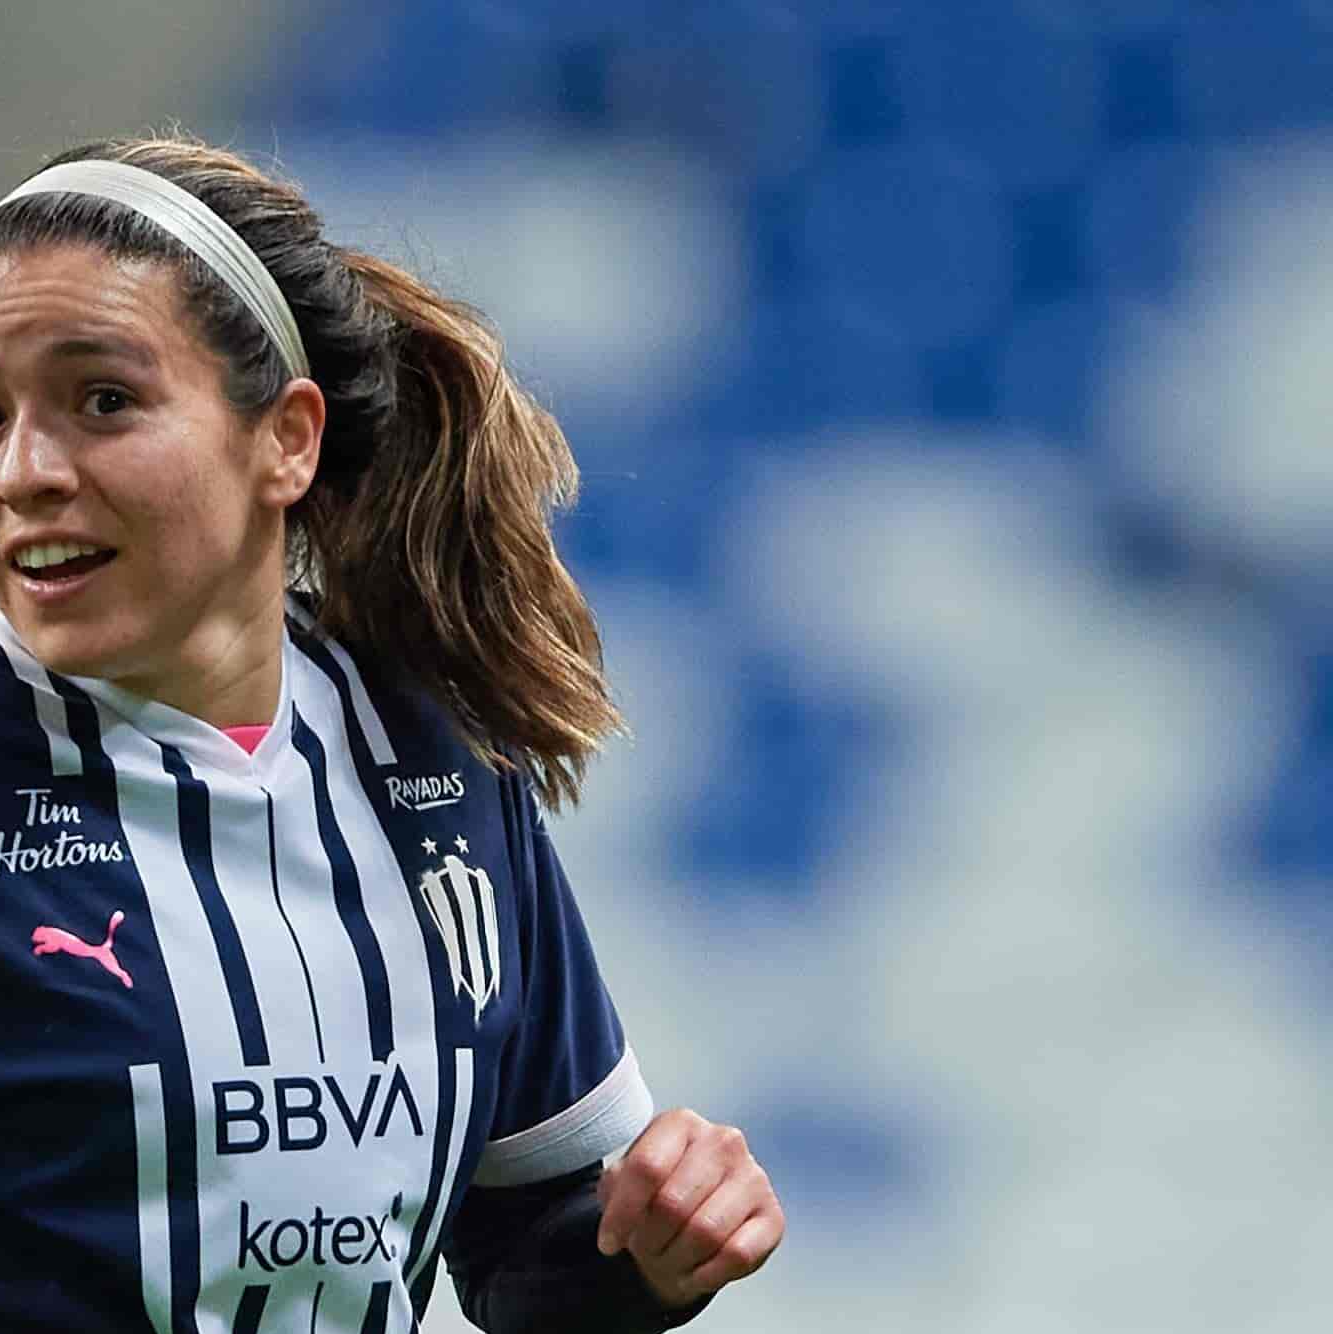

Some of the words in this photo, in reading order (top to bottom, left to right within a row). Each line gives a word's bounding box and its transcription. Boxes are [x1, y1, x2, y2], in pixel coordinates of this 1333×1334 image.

[15, 788, 82, 826] Tim
[385, 772, 465, 810] RAYADAS
[212, 1064, 424, 1155] BBVA
[238, 1200, 392, 1272] kotex
